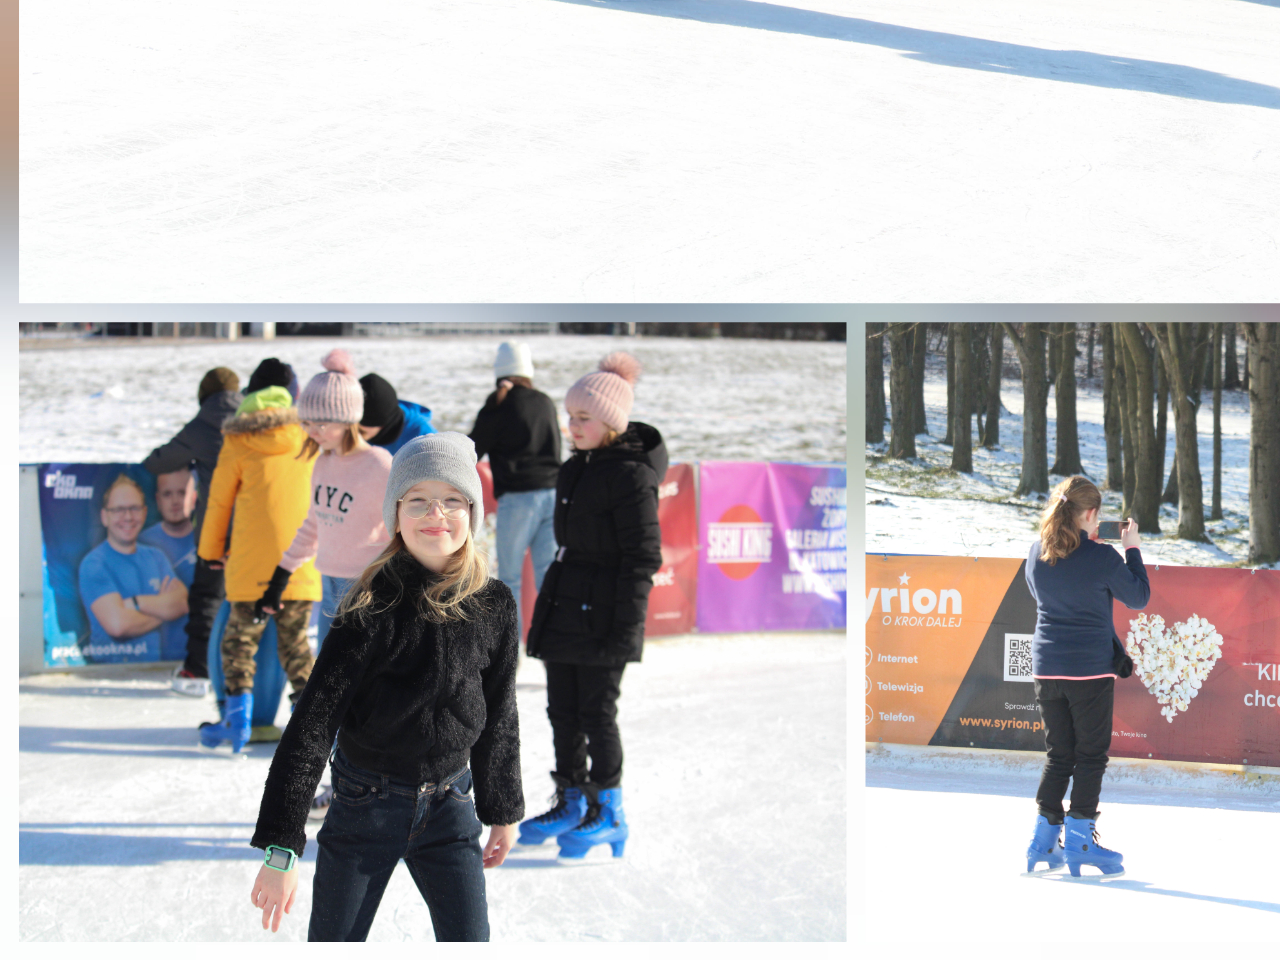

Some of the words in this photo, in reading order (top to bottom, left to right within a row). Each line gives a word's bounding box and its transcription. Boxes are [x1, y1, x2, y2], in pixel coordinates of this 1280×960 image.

[883, 615, 891, 625] O
[895, 617, 925, 627] KROK
[926, 618, 962, 628] DALEJ
[878, 653, 918, 664] Internet
[877, 681, 924, 693] Telewizja
[1004, 702, 1034, 711] Sprawdź
[878, 712, 914, 723] Telefon
[960, 717, 1044, 733] www.syrion.pl
